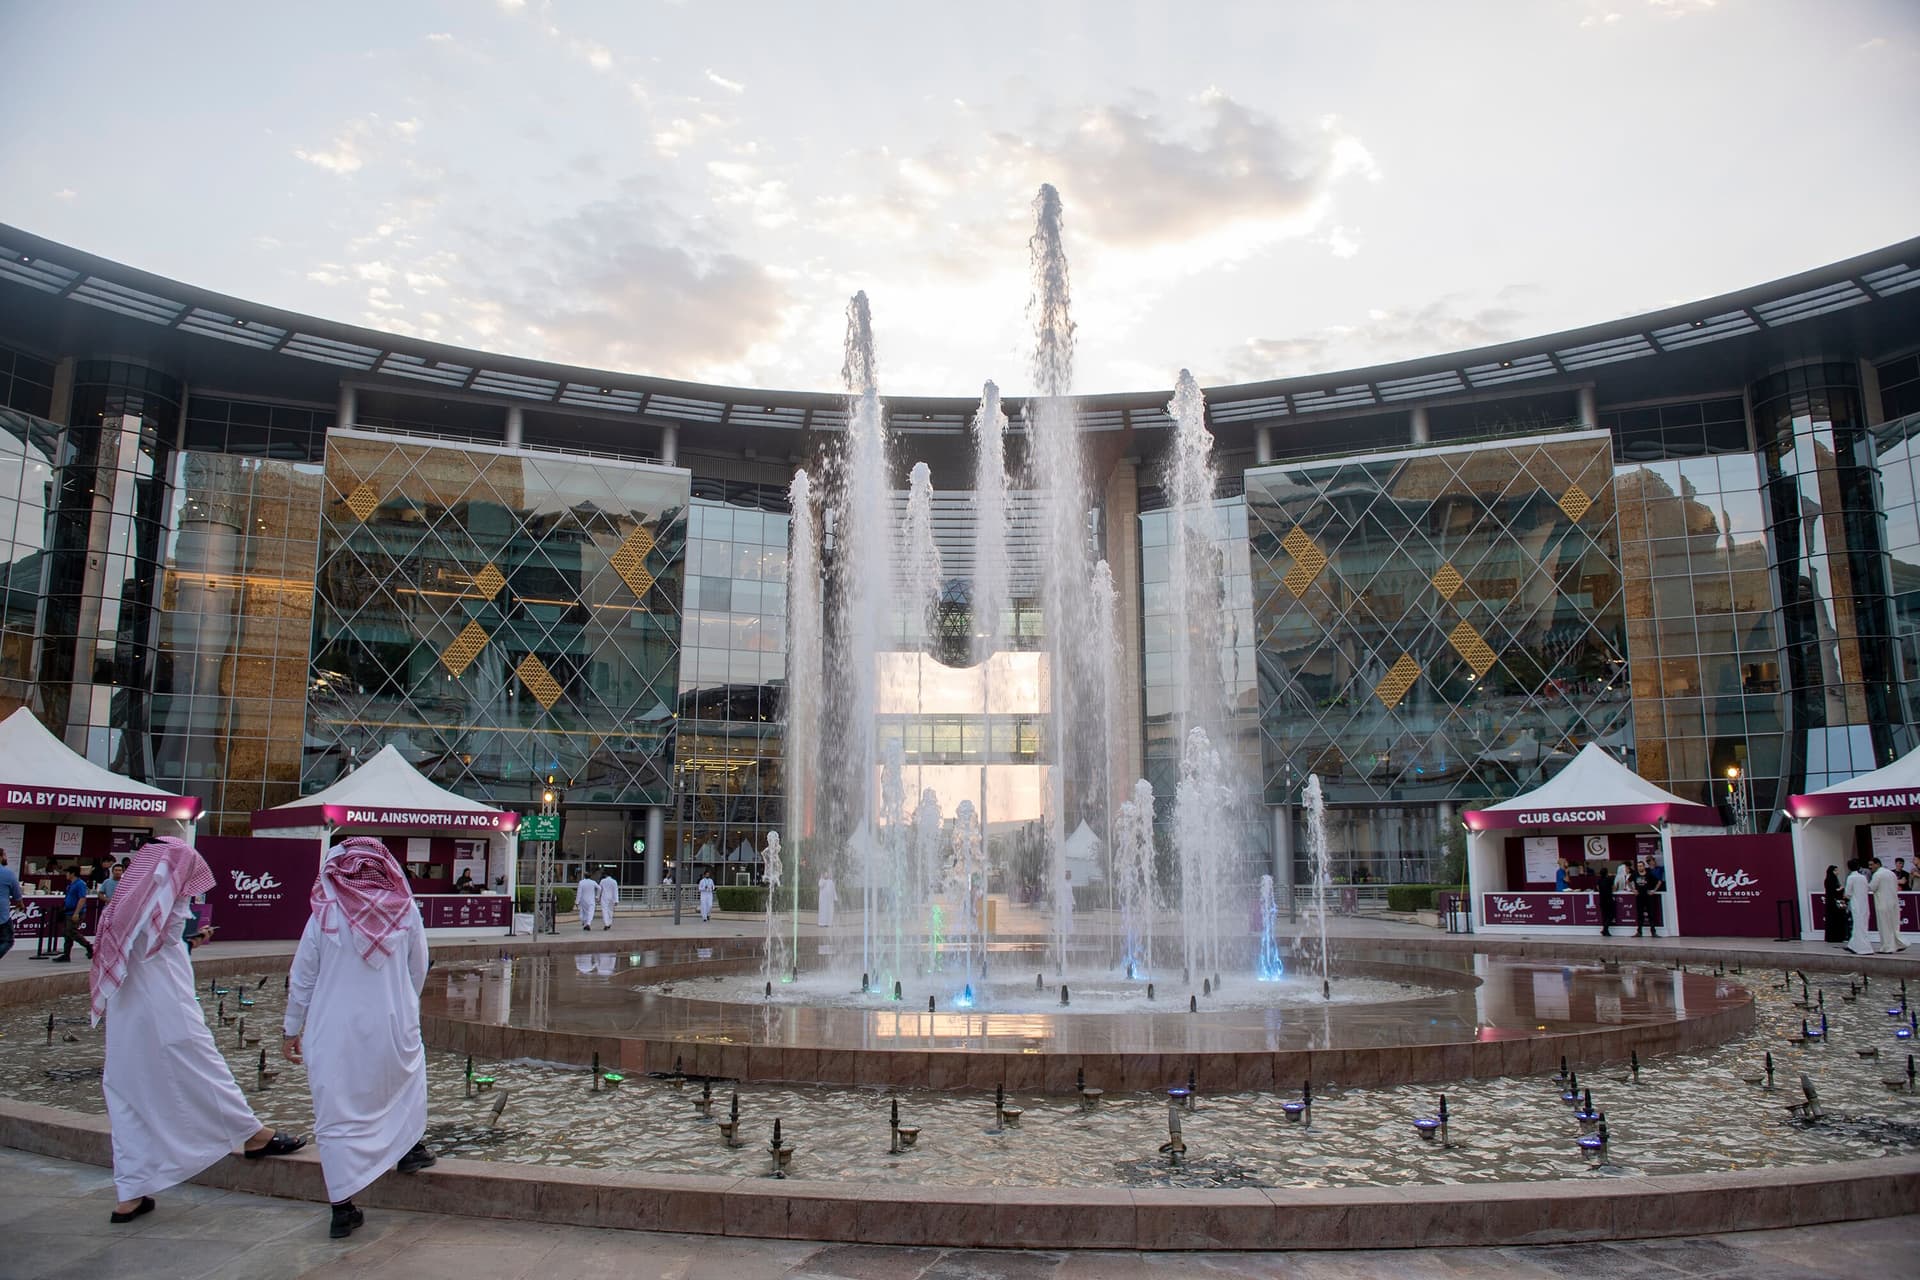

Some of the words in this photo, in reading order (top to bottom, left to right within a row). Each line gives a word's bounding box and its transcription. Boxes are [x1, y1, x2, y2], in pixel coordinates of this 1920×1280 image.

[7, 790, 33, 805] IDA
[36, 792, 55, 805] BY
[57, 794, 106, 808] DENNY
[108, 797, 167, 812] IMBROISI
[1848, 794, 1907, 809] ZELMAN
[346, 810, 378, 822] PAUL
[380, 812, 452, 825] AINSWORTH
[454, 815, 468, 825] AT
[470, 815, 490, 826] NO.
[492, 816, 499, 827] 6
[1518, 812, 1550, 824] CLUB
[1552, 810, 1606, 823] GASCON
[234, 871, 282, 894] taste
[1710, 868, 1759, 891] taste
[1496, 896, 1533, 914] taste
